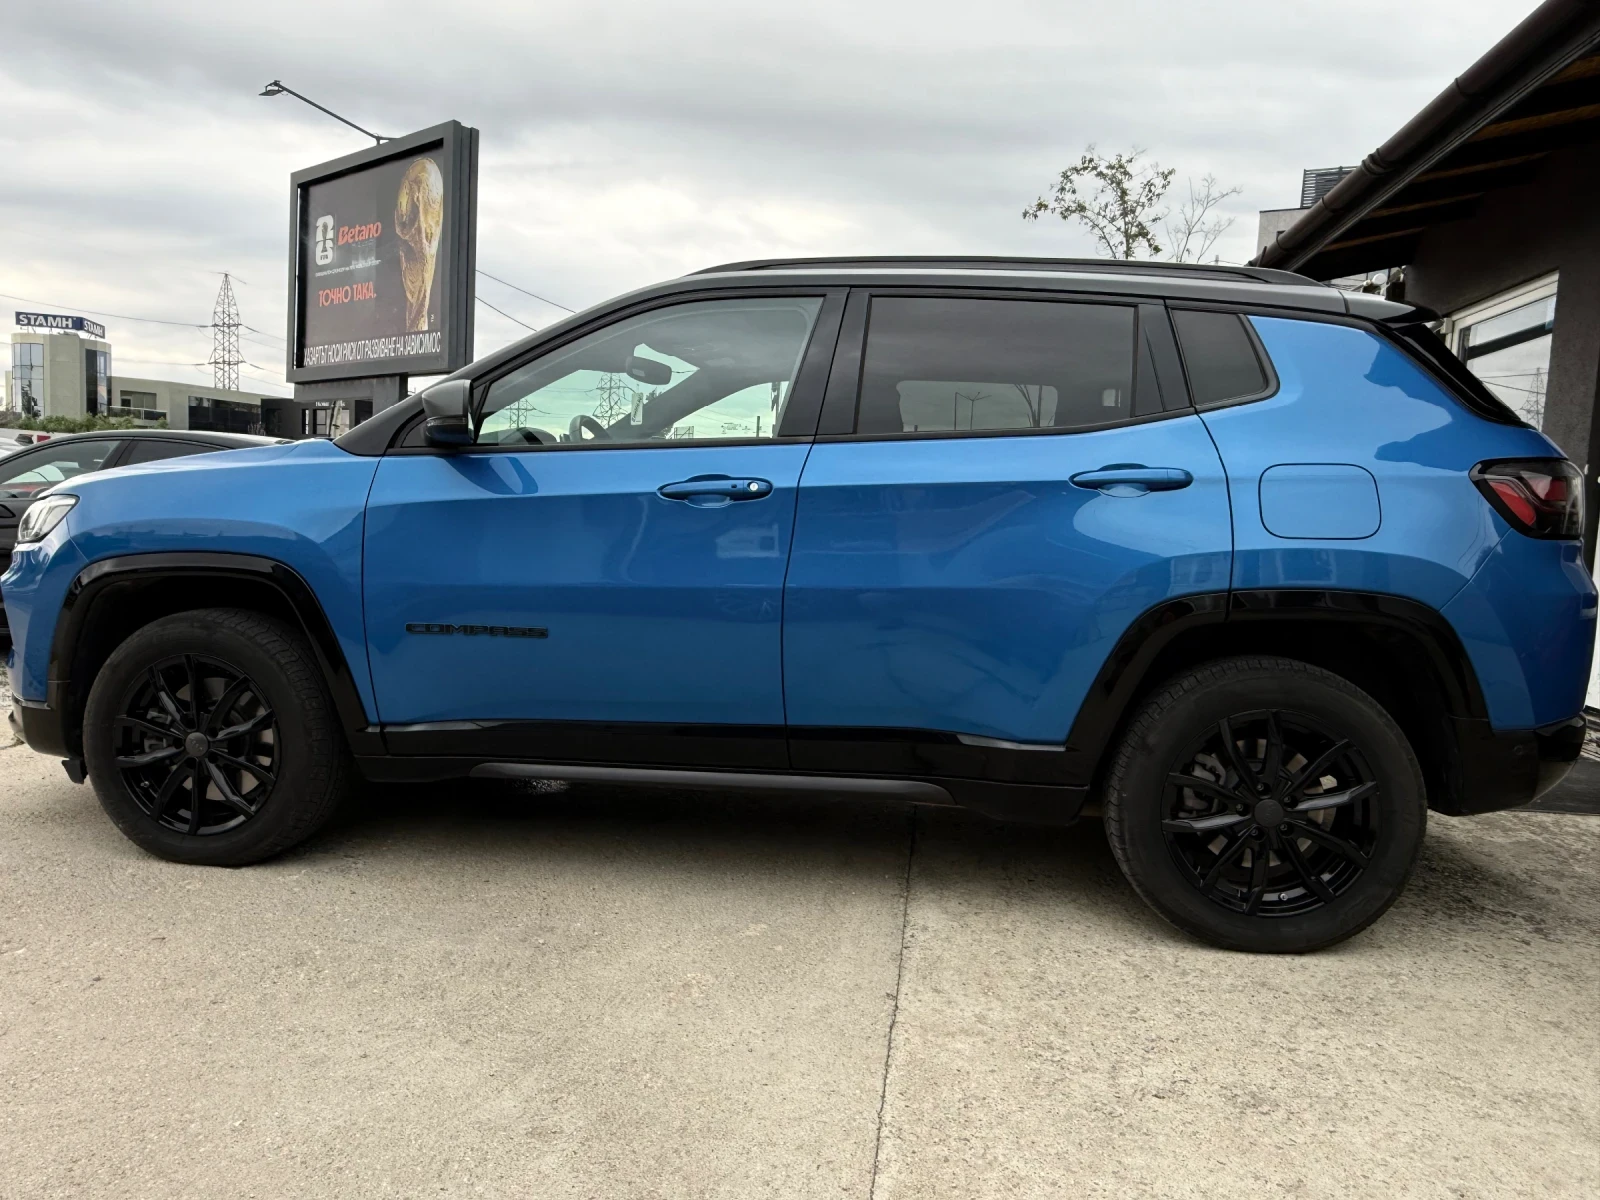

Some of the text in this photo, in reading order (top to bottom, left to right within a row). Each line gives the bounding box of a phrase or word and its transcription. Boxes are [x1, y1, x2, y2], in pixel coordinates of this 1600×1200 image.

[338, 221, 382, 246] Betano
[318, 281, 377, 307] ТОЧНО ТАКА.
[19, 314, 72, 328] STAMH
[84, 320, 103, 336] STAMH
[405, 623, 549, 639] COMPASS
